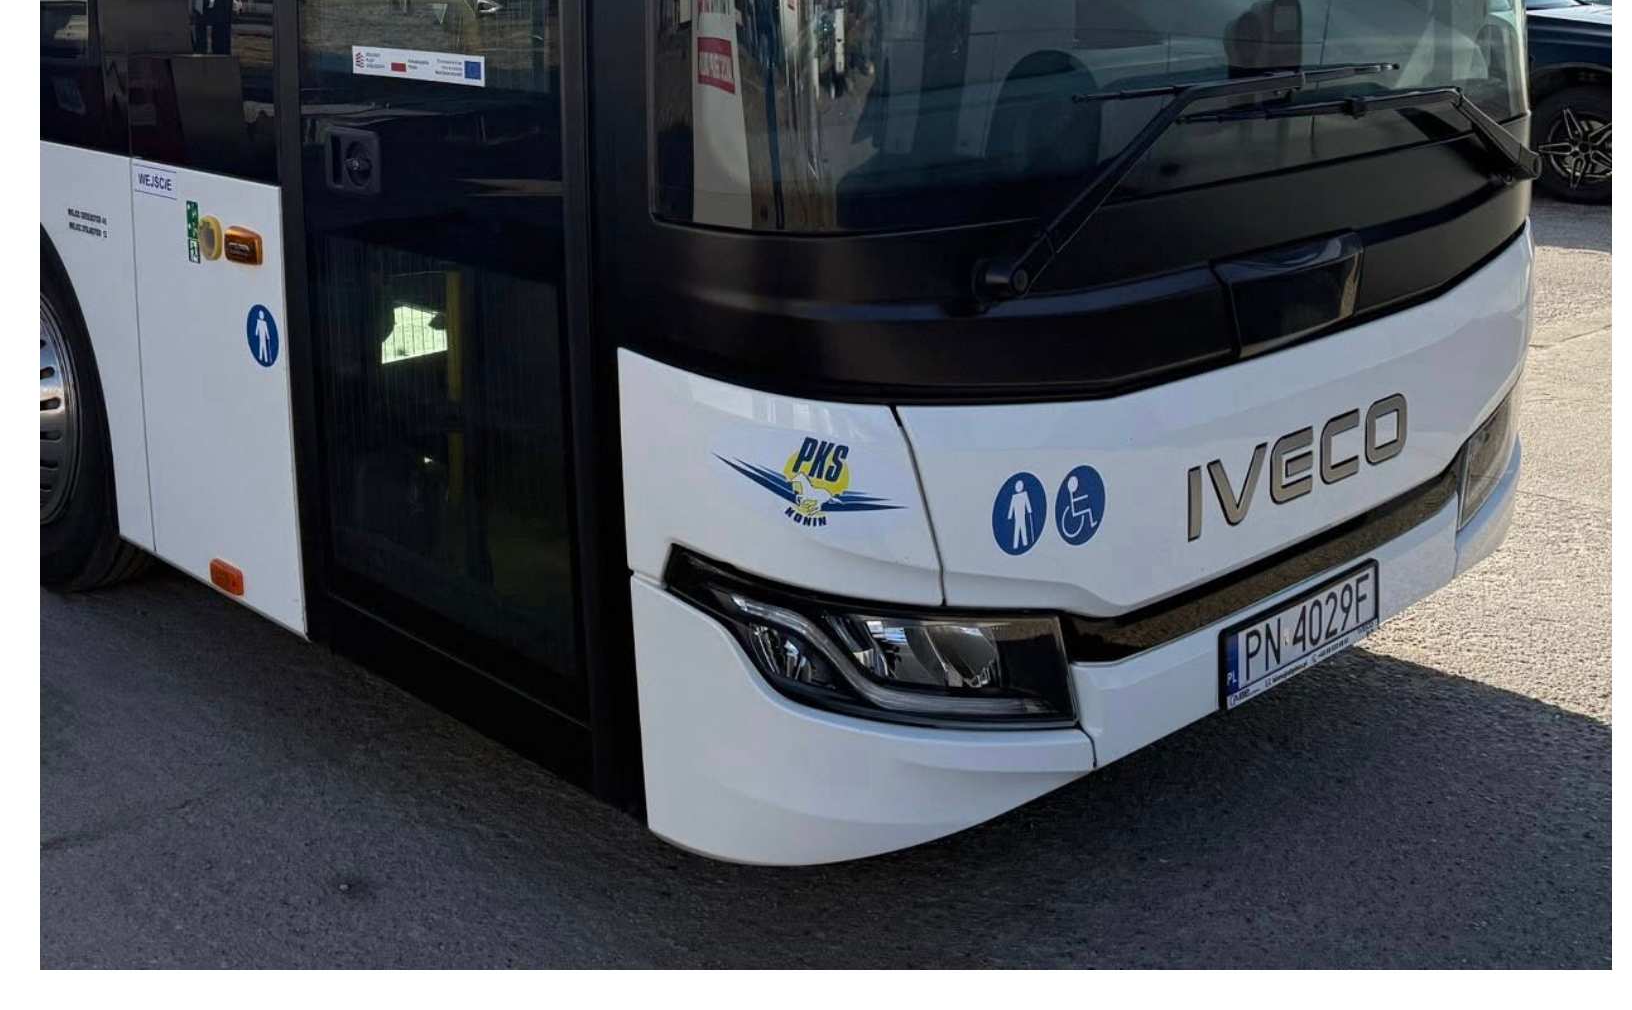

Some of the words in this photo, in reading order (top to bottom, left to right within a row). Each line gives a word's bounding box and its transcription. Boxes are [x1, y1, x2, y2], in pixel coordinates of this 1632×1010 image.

[792, 436, 850, 483] PKS
[1187, 392, 1407, 542] IVECO
[784, 506, 828, 528] KONIN
[1244, 619, 1281, 681] PN
[1290, 572, 1370, 652] 4029F
[1226, 670, 1238, 686] PL
